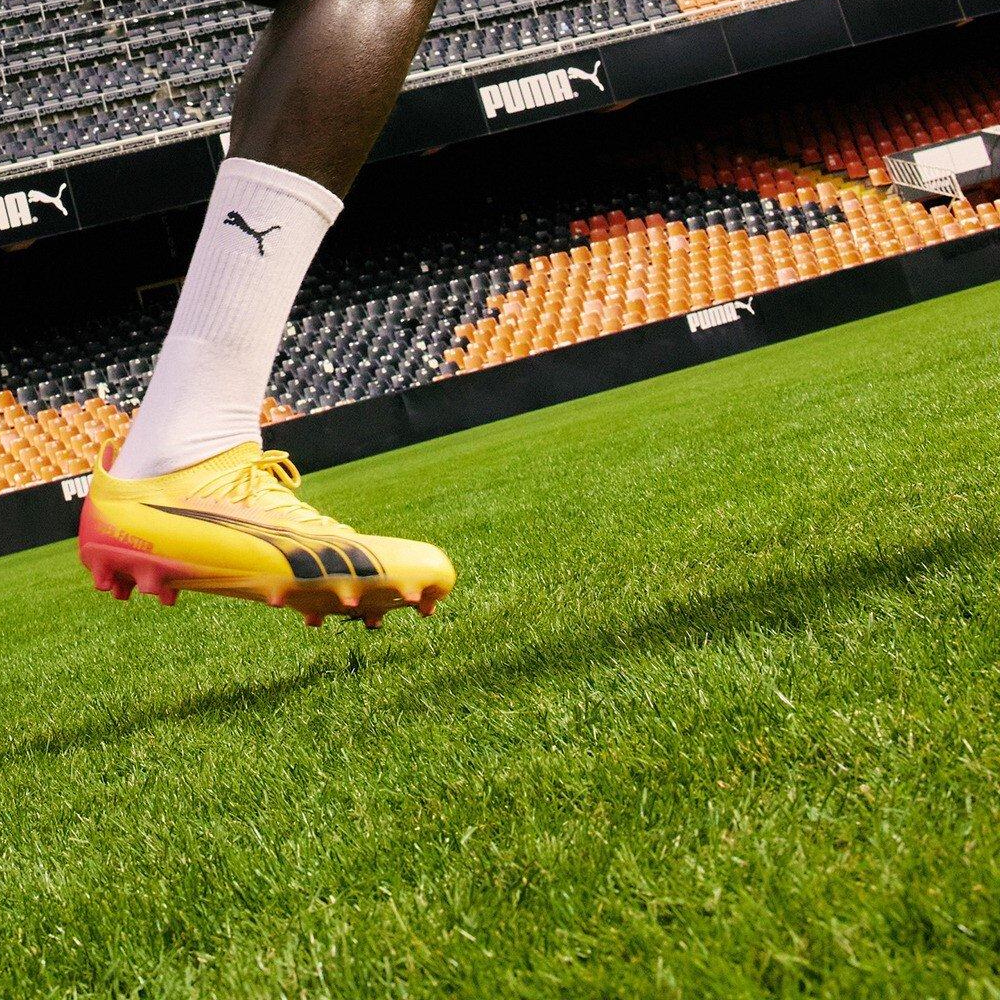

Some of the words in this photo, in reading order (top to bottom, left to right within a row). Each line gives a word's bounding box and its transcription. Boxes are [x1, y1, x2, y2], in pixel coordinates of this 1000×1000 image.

[479, 68, 575, 119] PUMA
[686, 301, 739, 333] PUMA
[61, 474, 94, 502] PU
